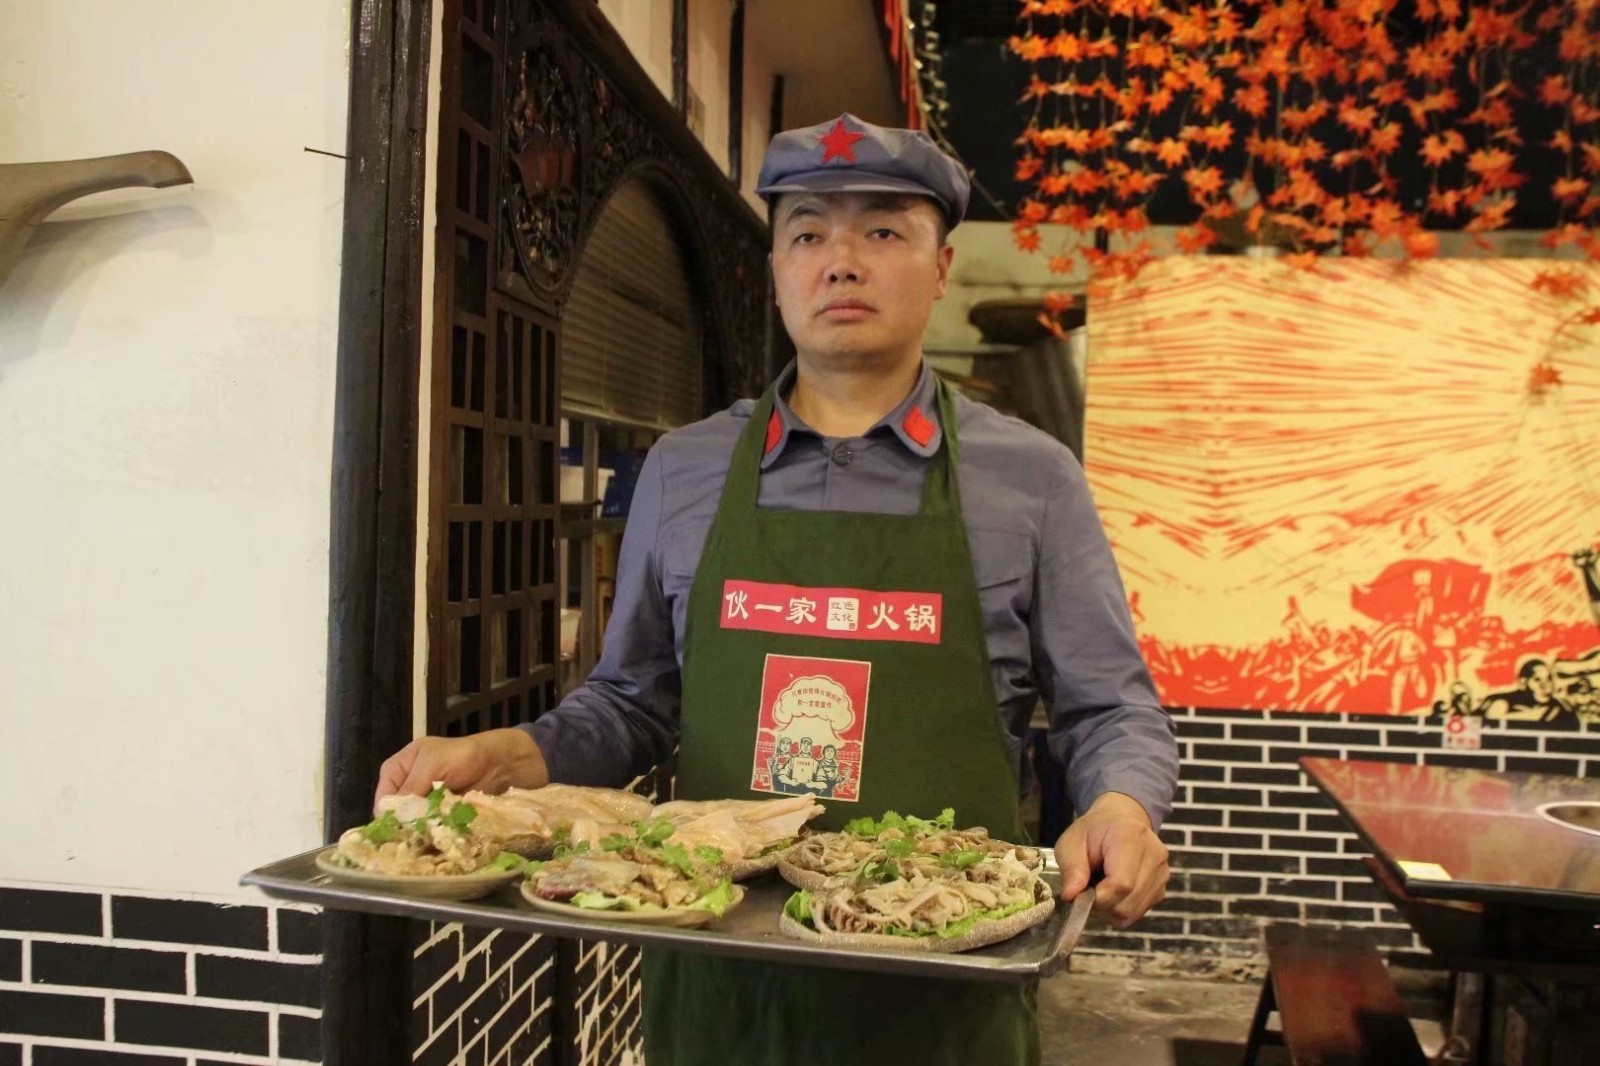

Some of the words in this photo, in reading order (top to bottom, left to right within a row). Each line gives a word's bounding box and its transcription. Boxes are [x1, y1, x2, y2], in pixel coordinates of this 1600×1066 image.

[830, 601, 855, 611] 红色
[725, 590, 817, 625] 伙一家
[867, 602, 936, 634] 火锅
[829, 612, 854, 622] 文化
